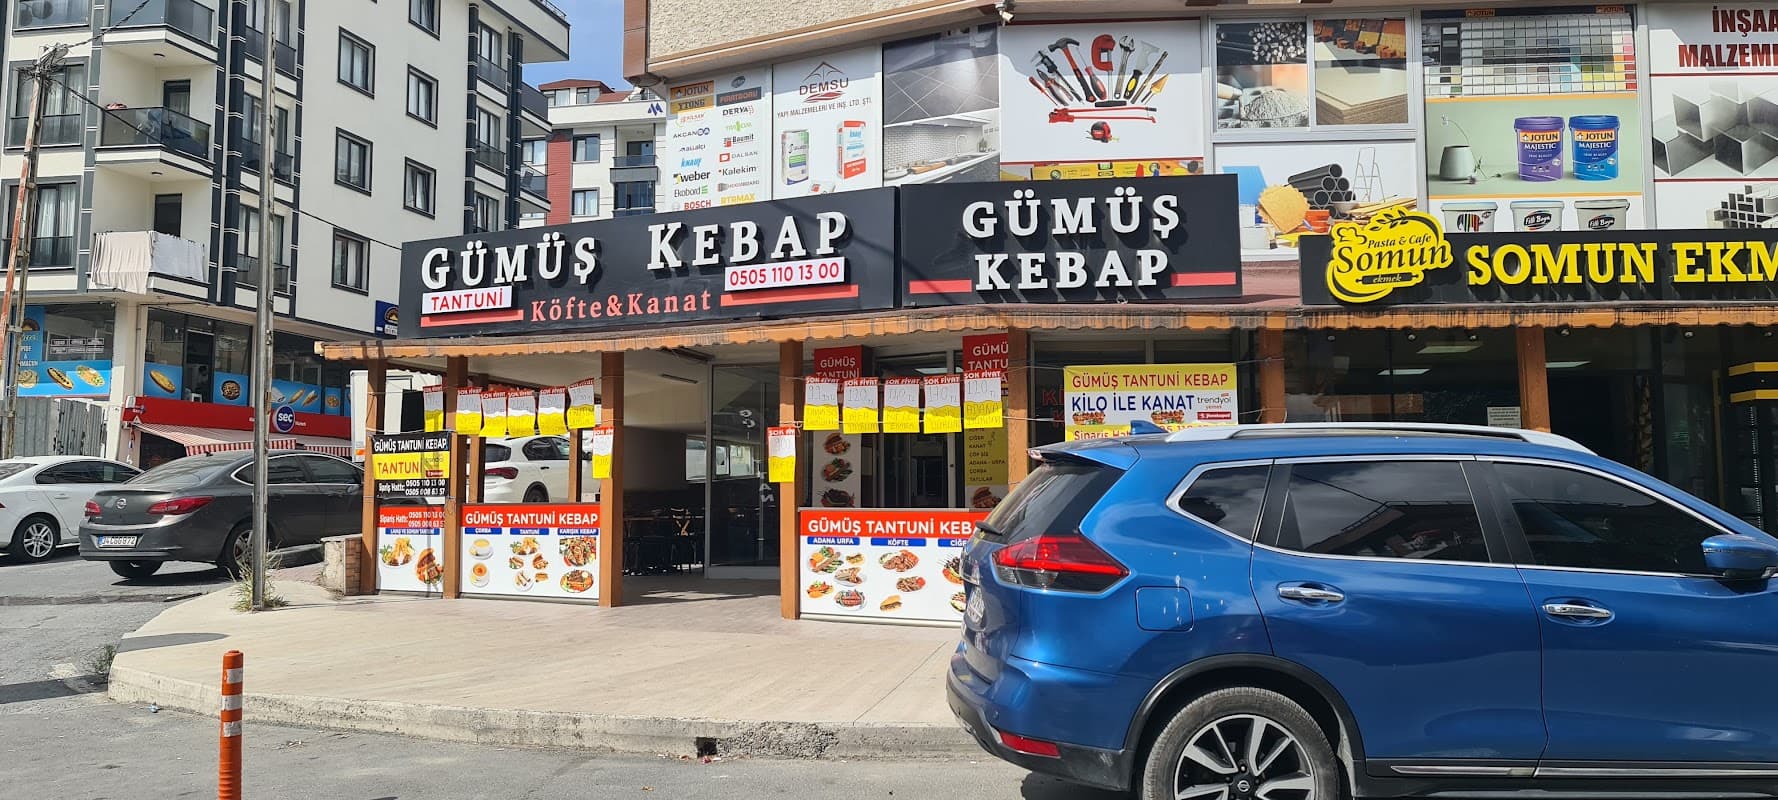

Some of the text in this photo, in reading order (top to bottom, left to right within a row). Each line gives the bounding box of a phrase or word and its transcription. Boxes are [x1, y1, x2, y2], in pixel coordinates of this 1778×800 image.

[684, 85, 709, 96] JOTUN
[800, 78, 848, 95] DEMSU
[1530, 133, 1558, 141] JOTUN
[1585, 132, 1613, 140] JOTUN
[1578, 141, 1611, 149] MAJESTIC
[680, 171, 711, 182] weber
[722, 166, 757, 176] Kalekim
[684, 200, 712, 210] BOSCH
[962, 186, 1180, 238] GÜMÜŞ
[1367, 232, 1431, 249] Pasta & Cafe
[421, 211, 847, 290] GÜMÜŞ KEBAP
[1336, 244, 1447, 273] Somun
[974, 249, 1169, 291] KEBAP
[1467, 241, 1657, 286] SOMUN
[730, 261, 839, 287] 0505 110 13 00
[431, 287, 503, 311] TANTUNİ
[820, 356, 856, 369] GÜMÜŞ
[1072, 371, 1228, 390] GÜMÜŞ TANTUNİ KEBAP
[1072, 393, 1107, 411] KİLO
[1113, 392, 1136, 411] İLE
[1142, 395, 1194, 411] KANAT
[1197, 395, 1232, 404] trendyol
[374, 437, 447, 453] GÜMÜŞ TANTUNİ KEBAP
[405, 479, 420, 487] 0505
[465, 510, 599, 526] GÜMÜŞ TANTUNİ KEBAP
[808, 516, 861, 536] GÜMÜŞ
[866, 518, 935, 534] TANTUNİ
[888, 538, 909, 546] KÖFTE
